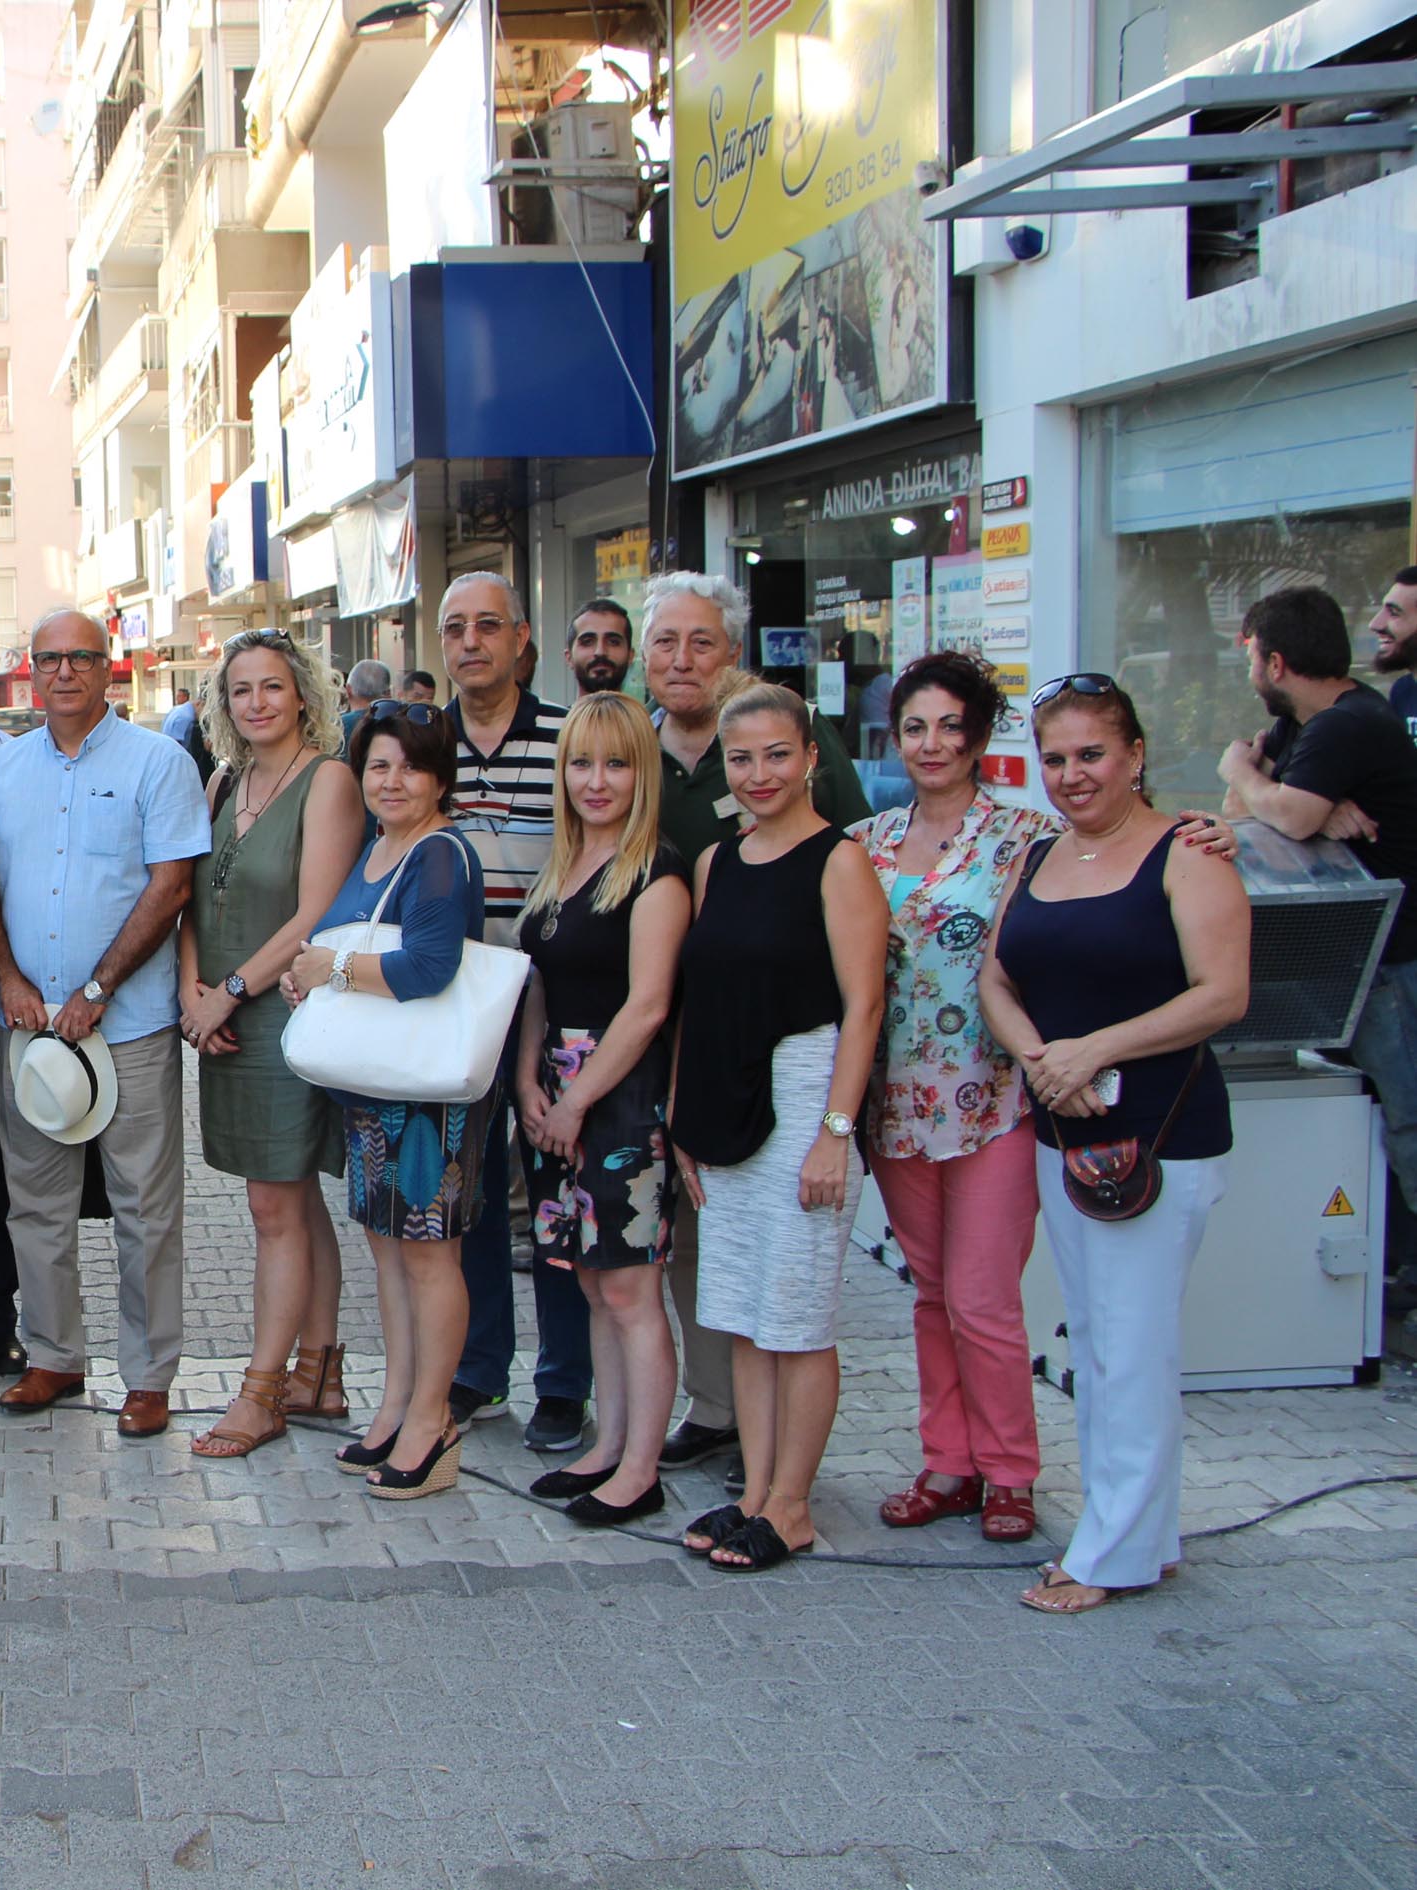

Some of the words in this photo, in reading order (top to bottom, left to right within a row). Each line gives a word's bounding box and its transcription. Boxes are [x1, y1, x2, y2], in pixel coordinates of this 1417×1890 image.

[694, 72, 772, 239] Stüdyo
[825, 166, 851, 208] 330
[857, 152, 875, 190] 36
[882, 138, 901, 176] 34
[822, 476, 884, 520] ANINDA
[892, 458, 952, 503] DİJİTAL
[959, 452, 982, 489] BA
[983, 481, 1012, 499] TURKISH
[983, 494, 1012, 512] AIRLINES
[987, 524, 1022, 545] PEGASUS
[990, 627, 1026, 640] SunExpress
[996, 673, 1024, 685] fthansa
